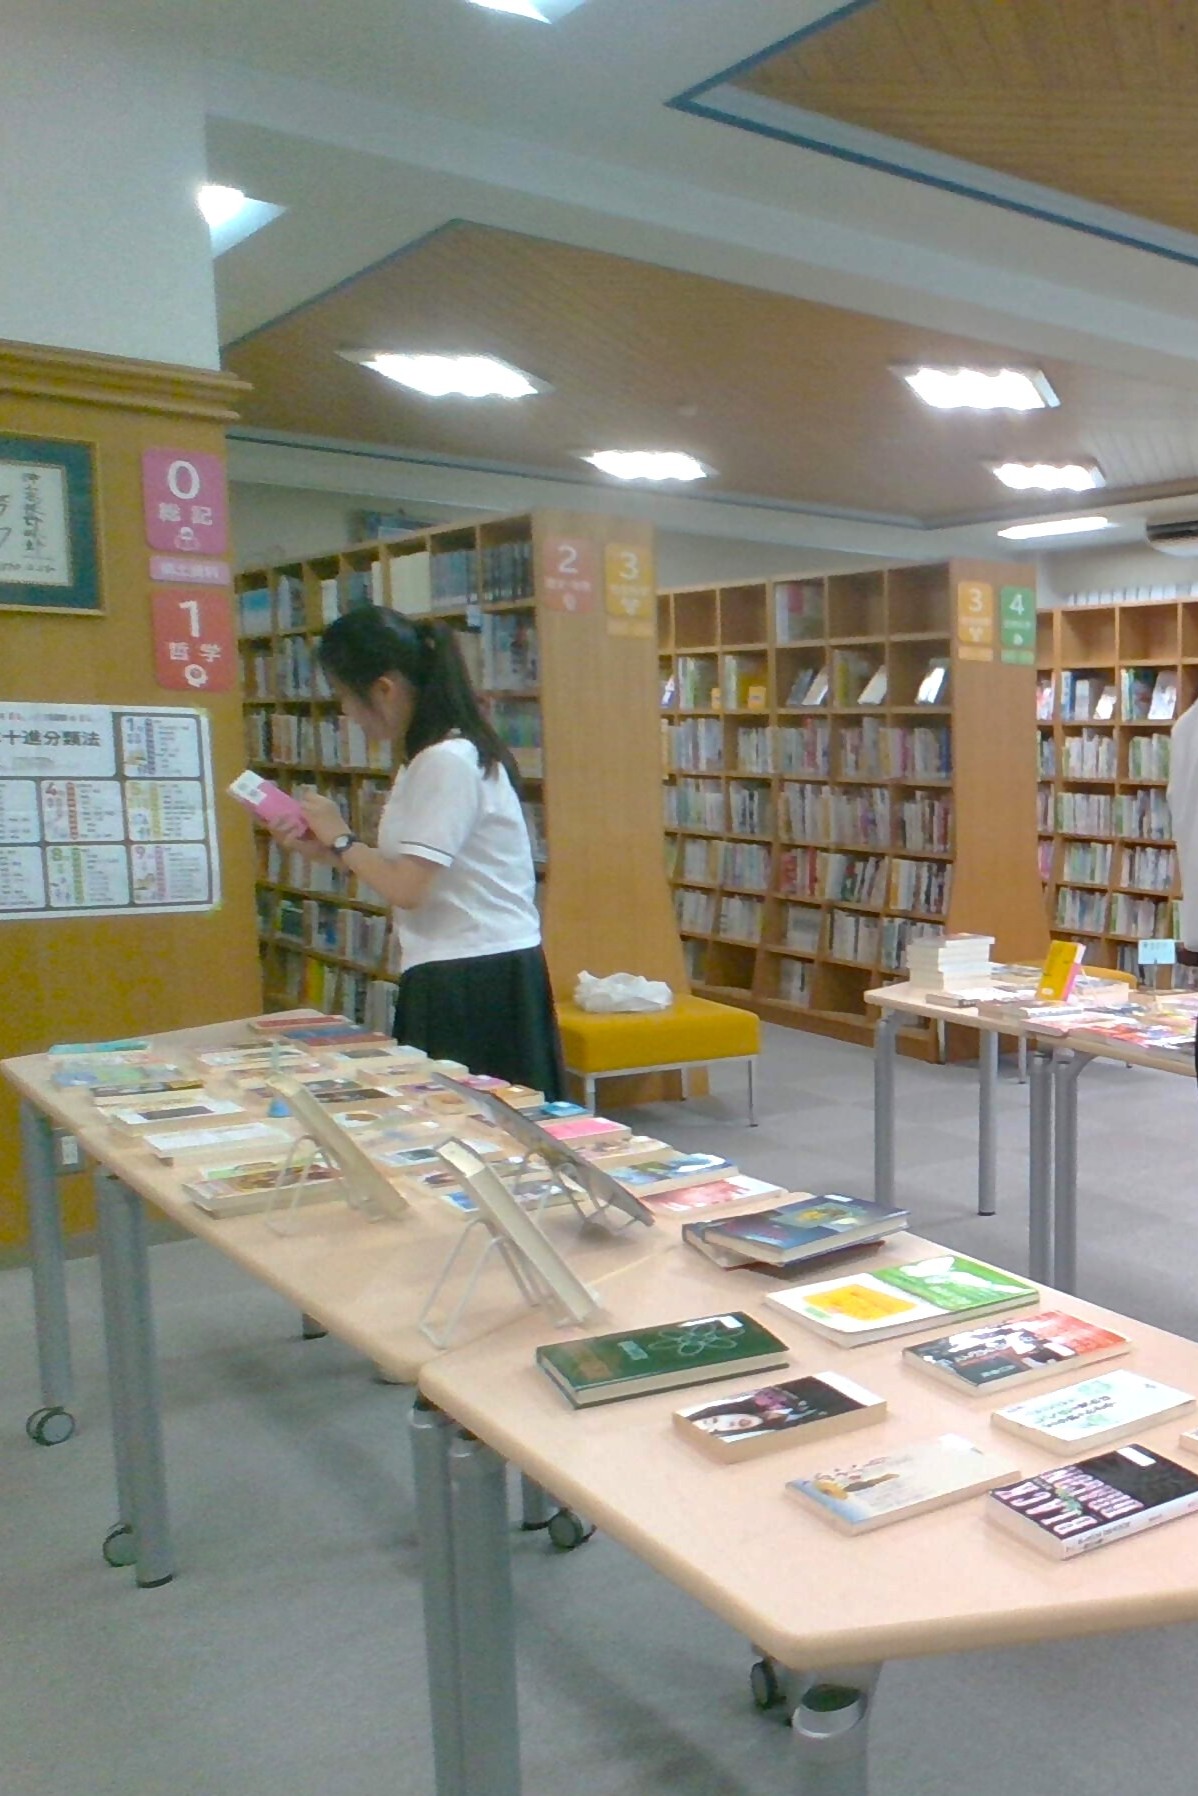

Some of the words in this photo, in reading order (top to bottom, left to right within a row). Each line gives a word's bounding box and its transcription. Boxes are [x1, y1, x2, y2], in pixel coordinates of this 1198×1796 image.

[167, 460, 200, 500] 0
[557, 545, 578, 574] 2
[619, 551, 638, 580] 3
[968, 587, 983, 613] 3
[1009, 593, 1025, 616] 4
[179, 600, 200, 638] 1
[0, 729, 101, 747] 十進分類法
[995, 1481, 1098, 1535] BLACK
